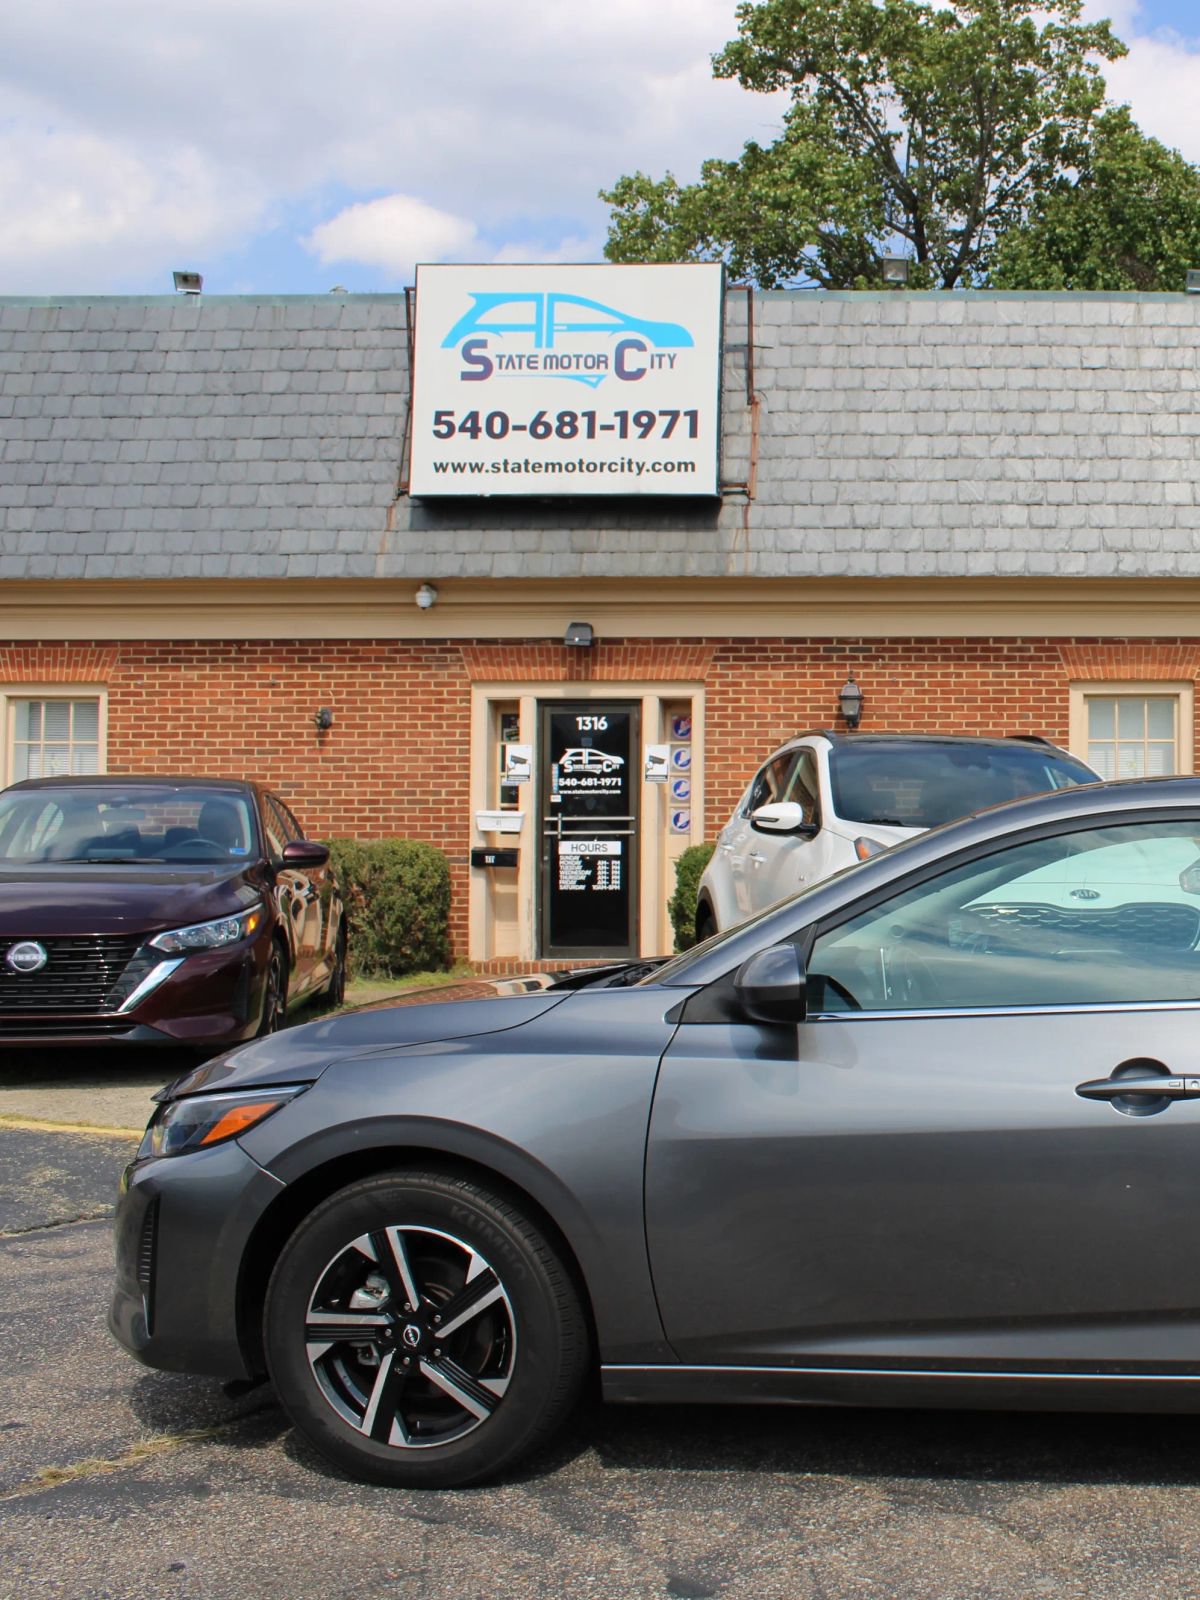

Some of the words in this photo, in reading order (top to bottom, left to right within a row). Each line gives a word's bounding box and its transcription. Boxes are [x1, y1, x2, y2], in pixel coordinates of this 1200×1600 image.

[543, 353, 608, 370] MOTOR
[432, 409, 699, 440] 540-681-1971
[432, 457, 696, 476] www.statemotorcity.com
[576, 716, 608, 730] 1316
[558, 777, 622, 787] 540-681-1971
[570, 843, 608, 853] HOURS
